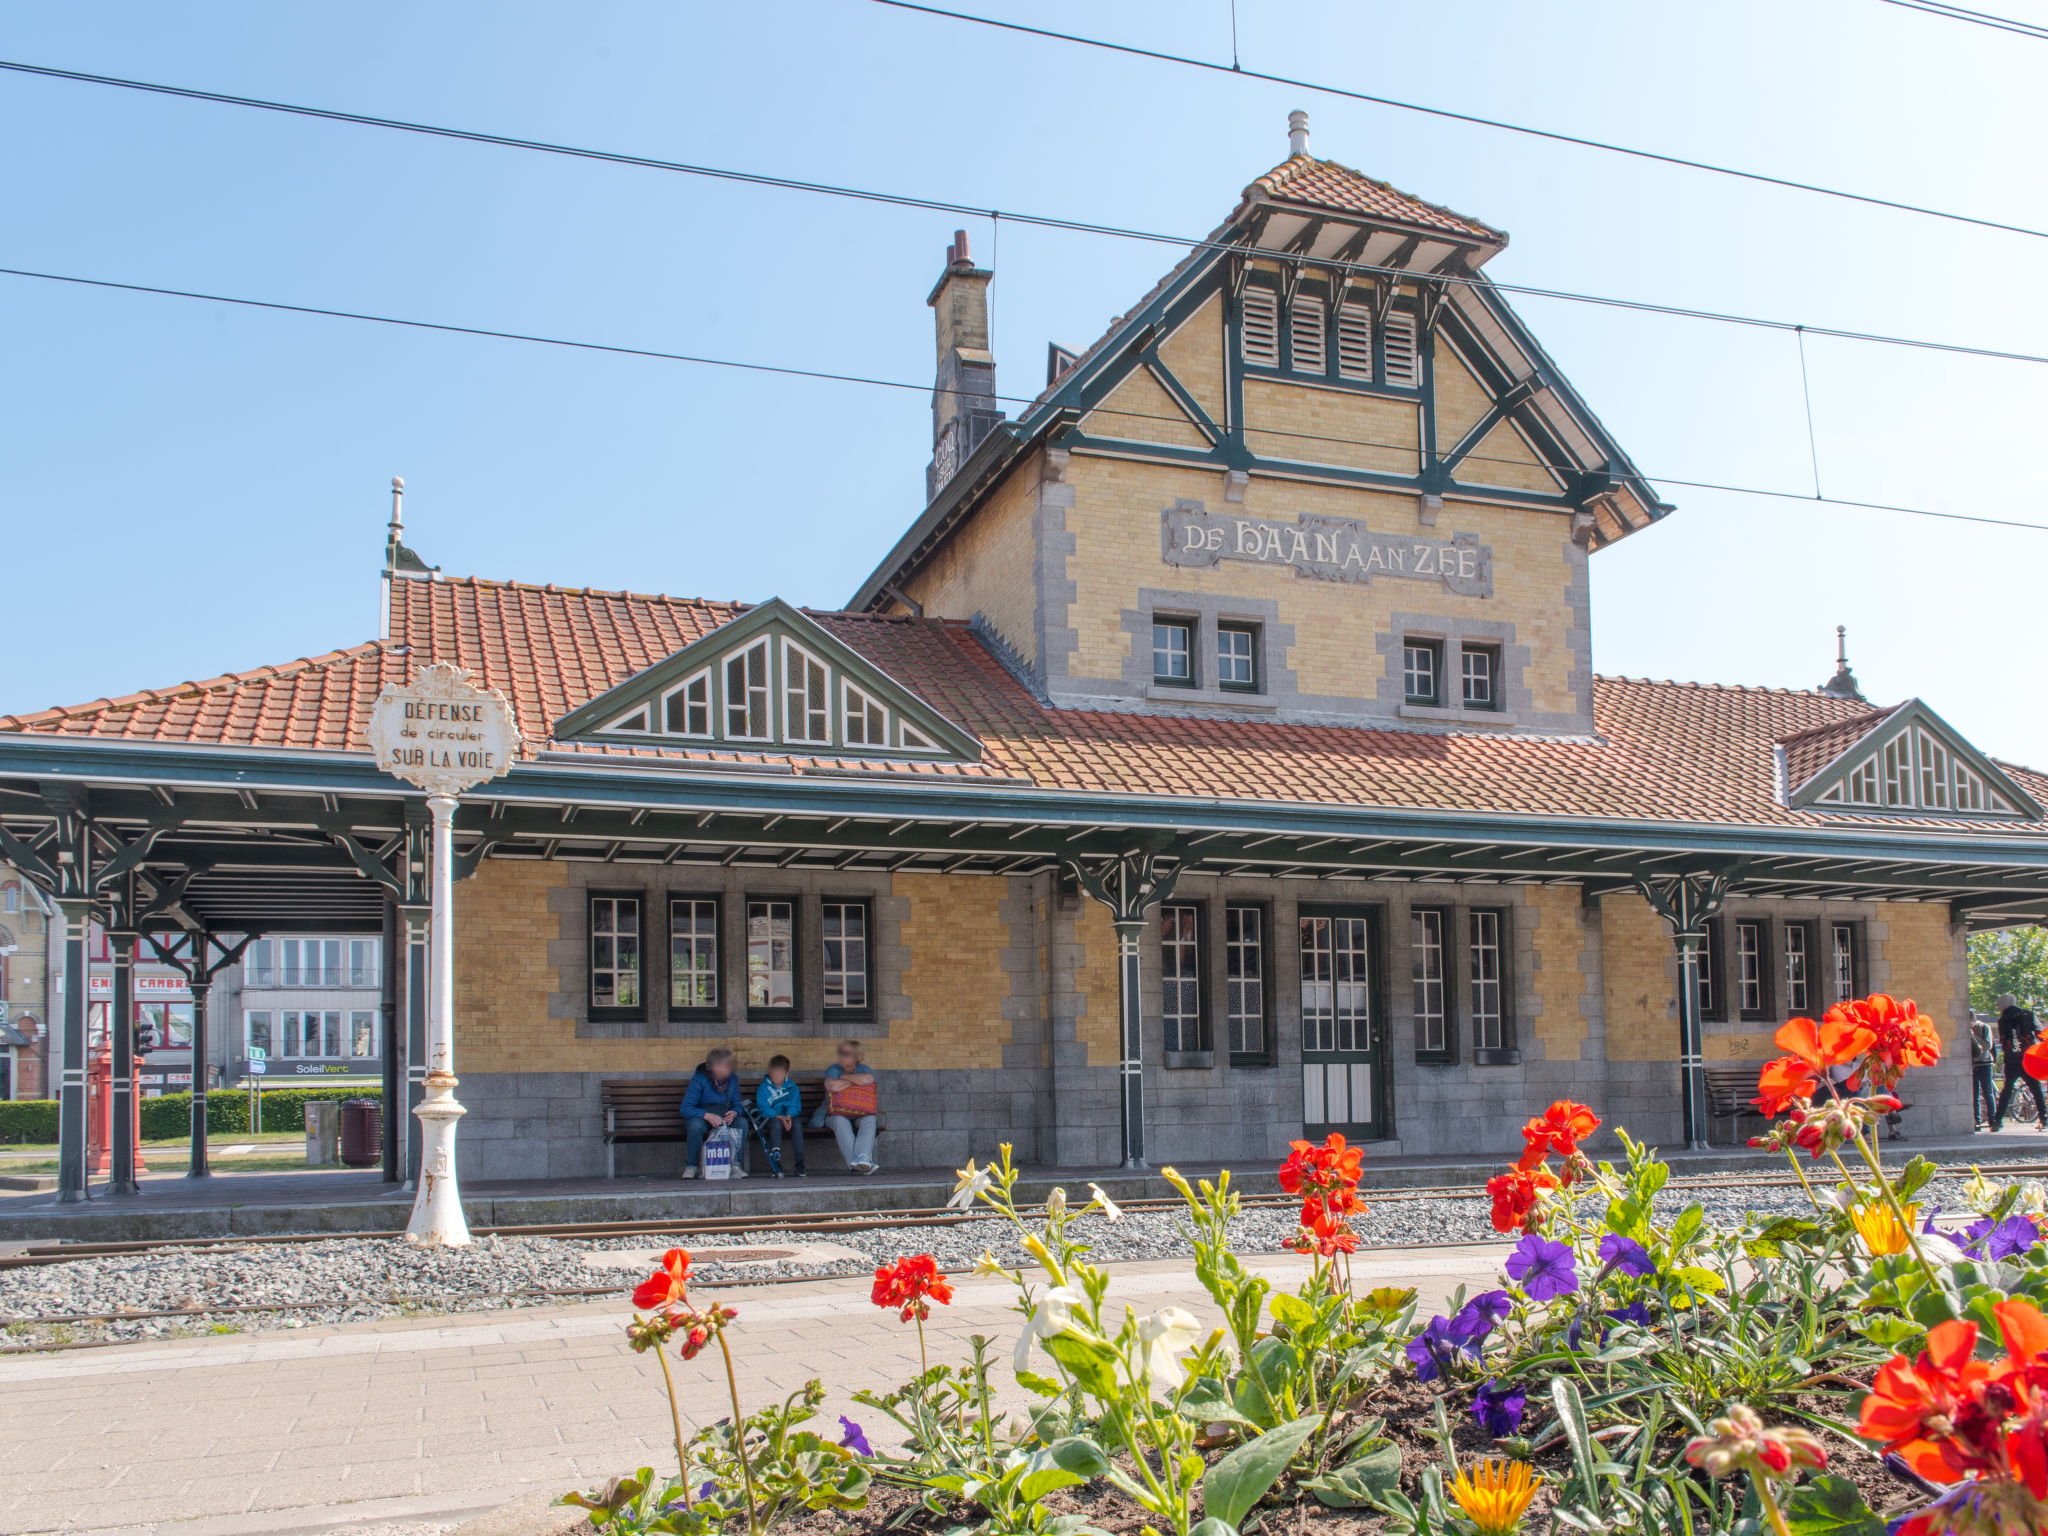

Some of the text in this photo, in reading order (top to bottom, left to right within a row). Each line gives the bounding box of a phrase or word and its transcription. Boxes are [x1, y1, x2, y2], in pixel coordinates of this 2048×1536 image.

[935, 431, 954, 468] COQ
[1183, 520, 1477, 578] DE HAAN AAN ZEE
[405, 699, 483, 722] DÉFENSE
[401, 725, 486, 741] de circuler
[392, 747, 494, 769] SUR LA VOIE
[707, 1147, 730, 1158] man
